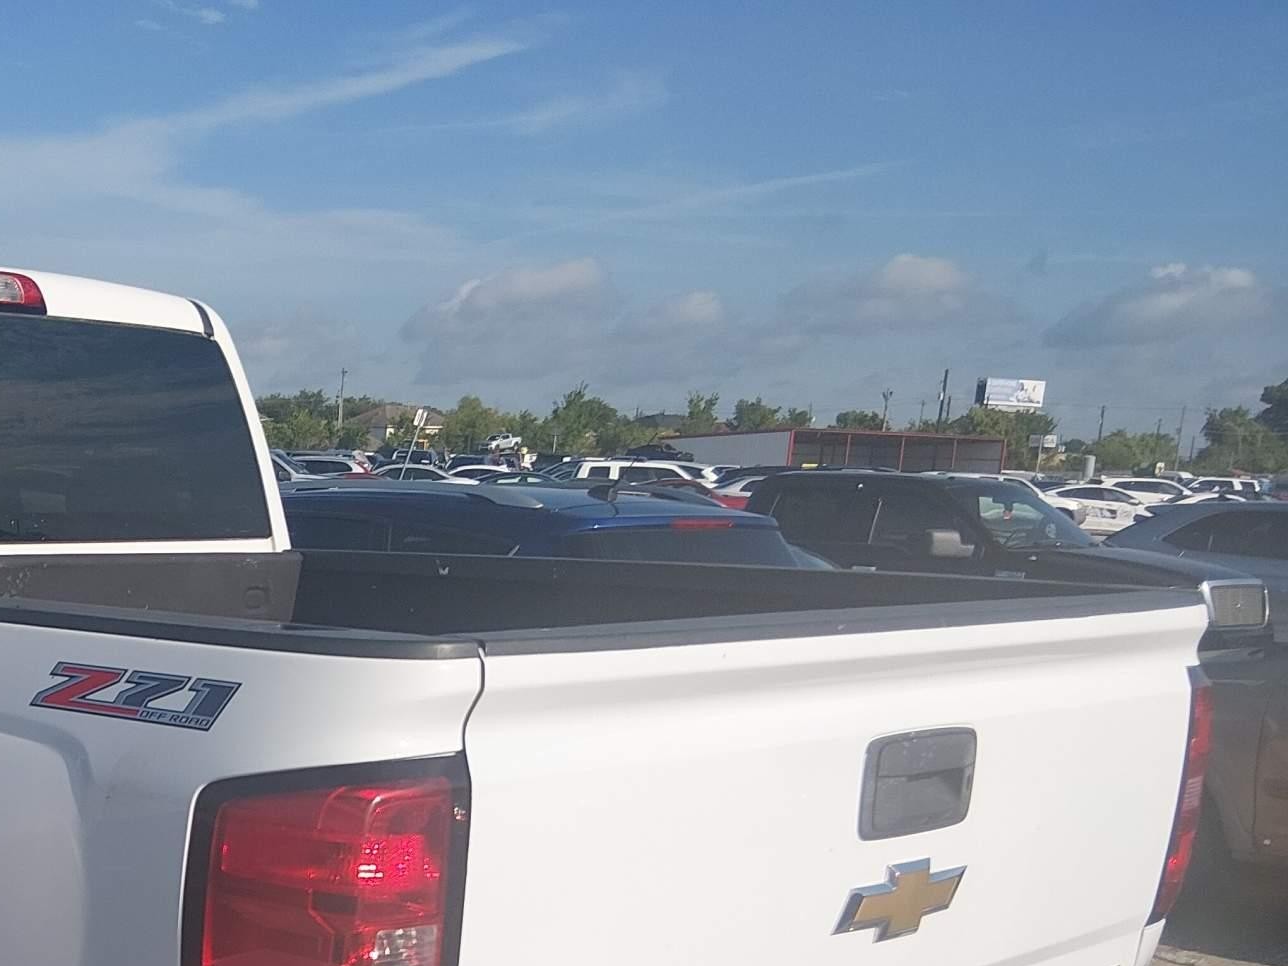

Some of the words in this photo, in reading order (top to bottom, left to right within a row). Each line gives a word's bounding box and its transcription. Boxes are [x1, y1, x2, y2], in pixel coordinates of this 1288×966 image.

[30, 661, 243, 731] Z71
[139, 710, 167, 721] OFF
[169, 714, 211, 727] ROAD
